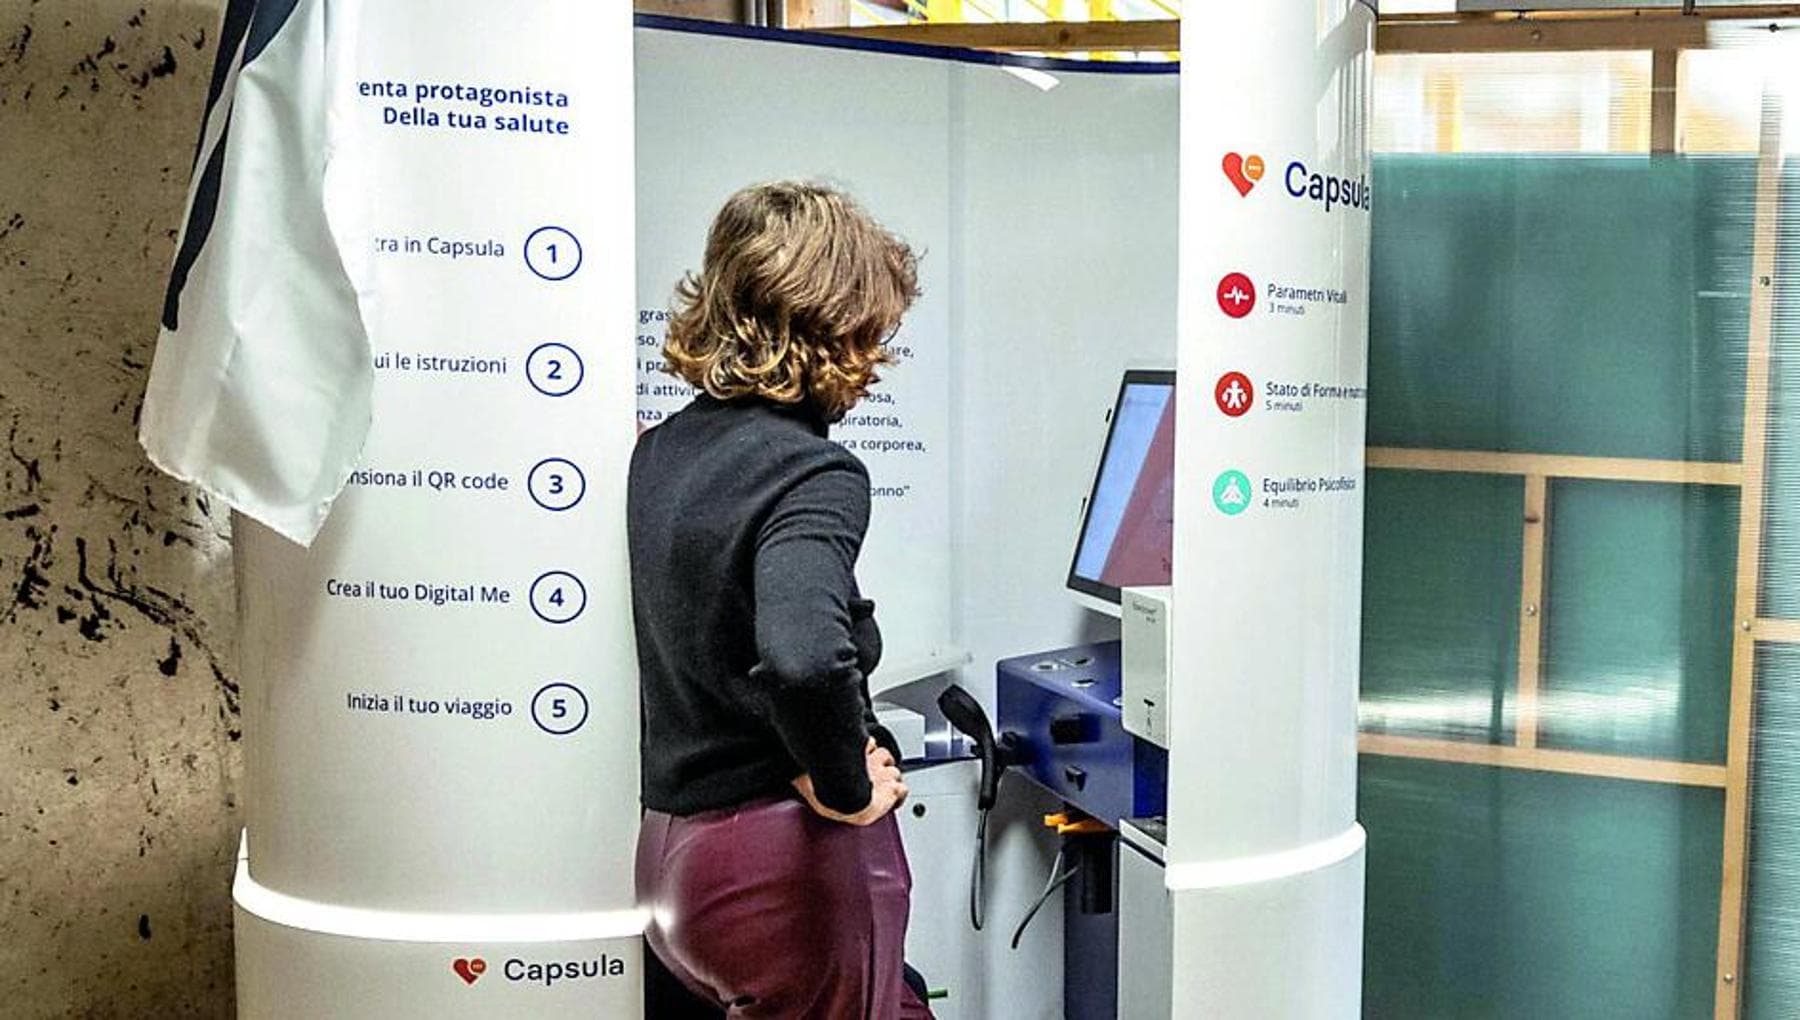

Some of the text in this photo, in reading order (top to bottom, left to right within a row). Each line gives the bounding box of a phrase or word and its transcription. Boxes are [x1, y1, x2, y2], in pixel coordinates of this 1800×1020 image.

[356, 81, 569, 107] enta protagonista
[384, 107, 569, 135] Della tua salute
[1285, 161, 1369, 212] Capsula
[404, 236, 421, 253] in
[427, 237, 505, 258] Capsula
[546, 244, 557, 264] 1
[1267, 283, 1325, 302] Parametri
[395, 352, 411, 370] le
[417, 353, 507, 374] istruzioni
[547, 360, 562, 380] 2
[865, 391, 895, 405] osa,
[1265, 381, 1299, 397] Stato
[1301, 382, 1311, 397] di
[1265, 400, 1272, 411] 5
[861, 440, 926, 453] corporea,
[346, 468, 509, 490] nsiona il QR code
[549, 475, 564, 495] 3
[1263, 478, 1316, 496] Equilibrio
[1263, 498, 1269, 507] 4
[327, 579, 510, 605] Crea il tuo Digital Me
[549, 588, 564, 607] 4
[348, 693, 512, 719] Inizia il tuo viaggio
[552, 699, 567, 718] 5
[505, 954, 624, 986] Capsula
